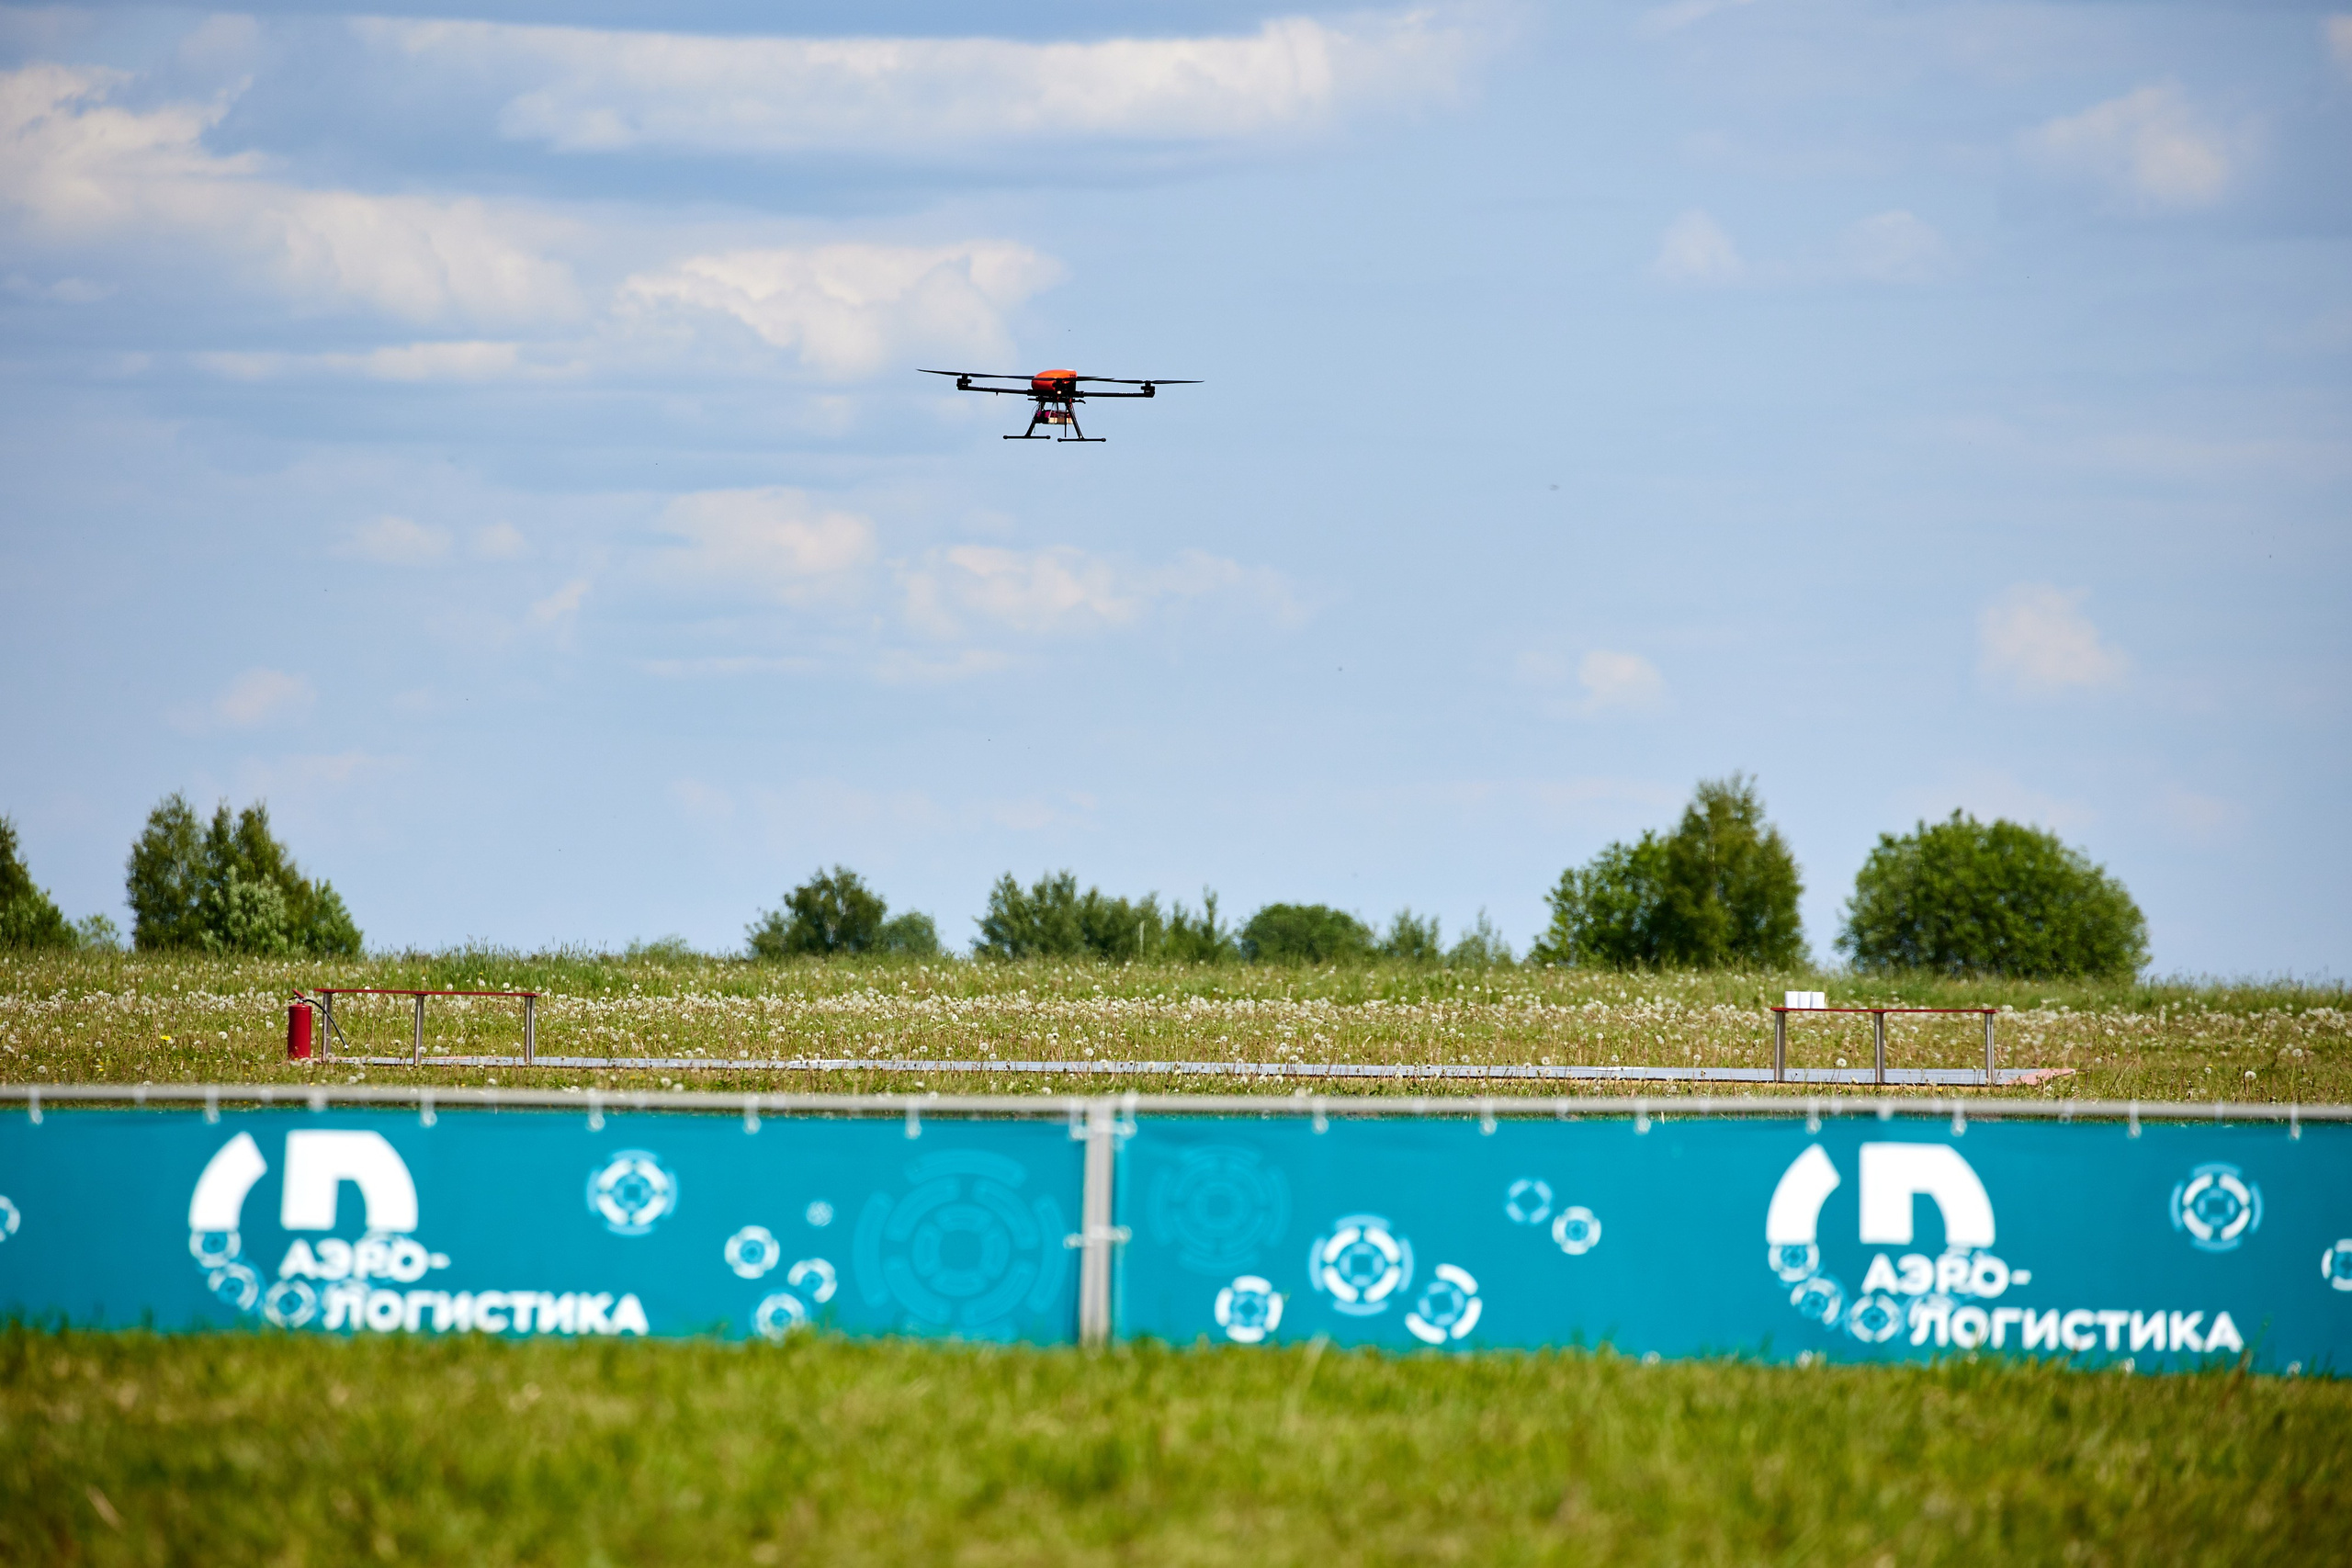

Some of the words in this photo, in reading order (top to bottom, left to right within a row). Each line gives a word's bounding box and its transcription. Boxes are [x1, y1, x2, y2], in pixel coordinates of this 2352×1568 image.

[278, 1238, 451, 1282] АЭРО-
[1862, 1253, 2031, 1299] АЭРО-
[322, 1290, 649, 1335] ЛОГИСТИКА
[1910, 1307, 2244, 1352] ЛОГИСТИКА
